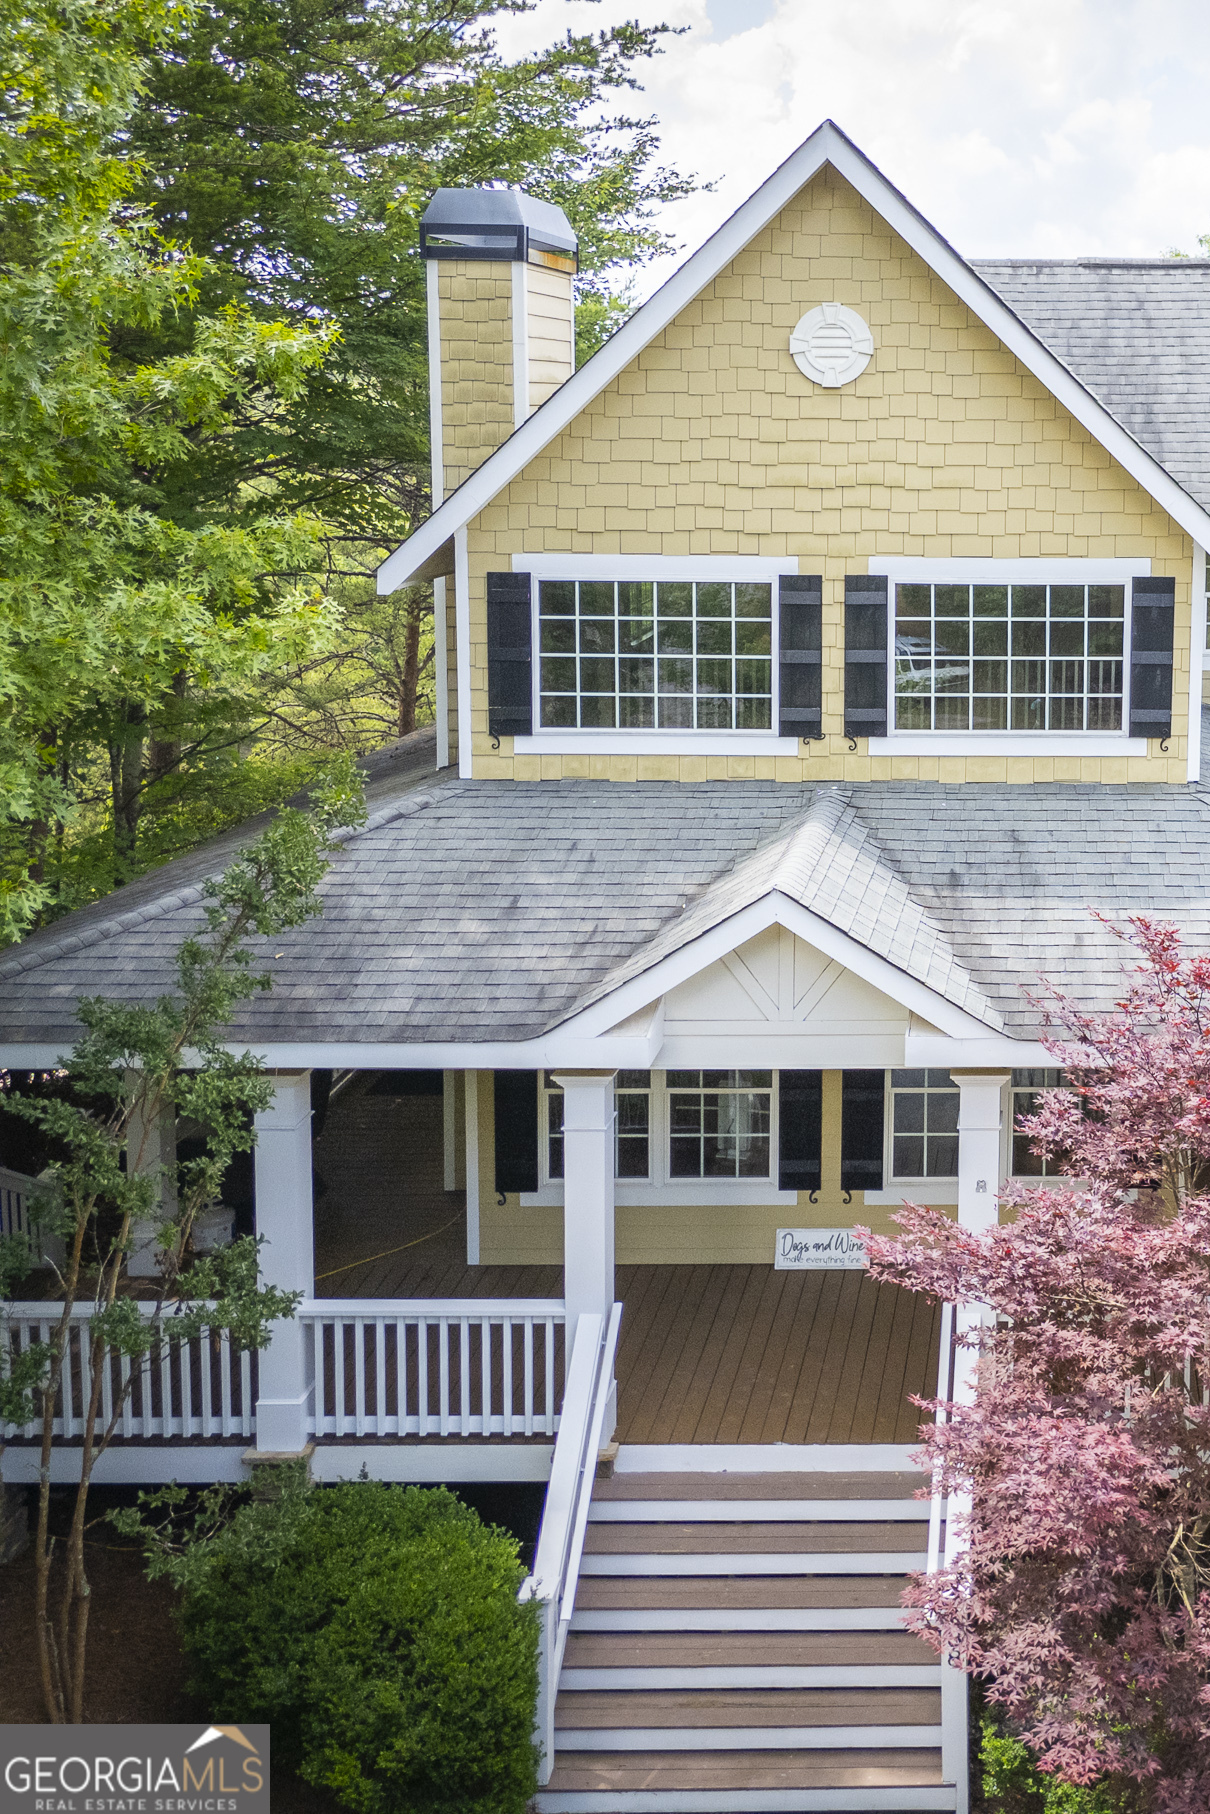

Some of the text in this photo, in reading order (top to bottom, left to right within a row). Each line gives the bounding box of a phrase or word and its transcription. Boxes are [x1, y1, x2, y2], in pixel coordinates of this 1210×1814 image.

[781, 1232, 865, 1258] Dogs and Wine
[805, 1256, 845, 1266] everything
